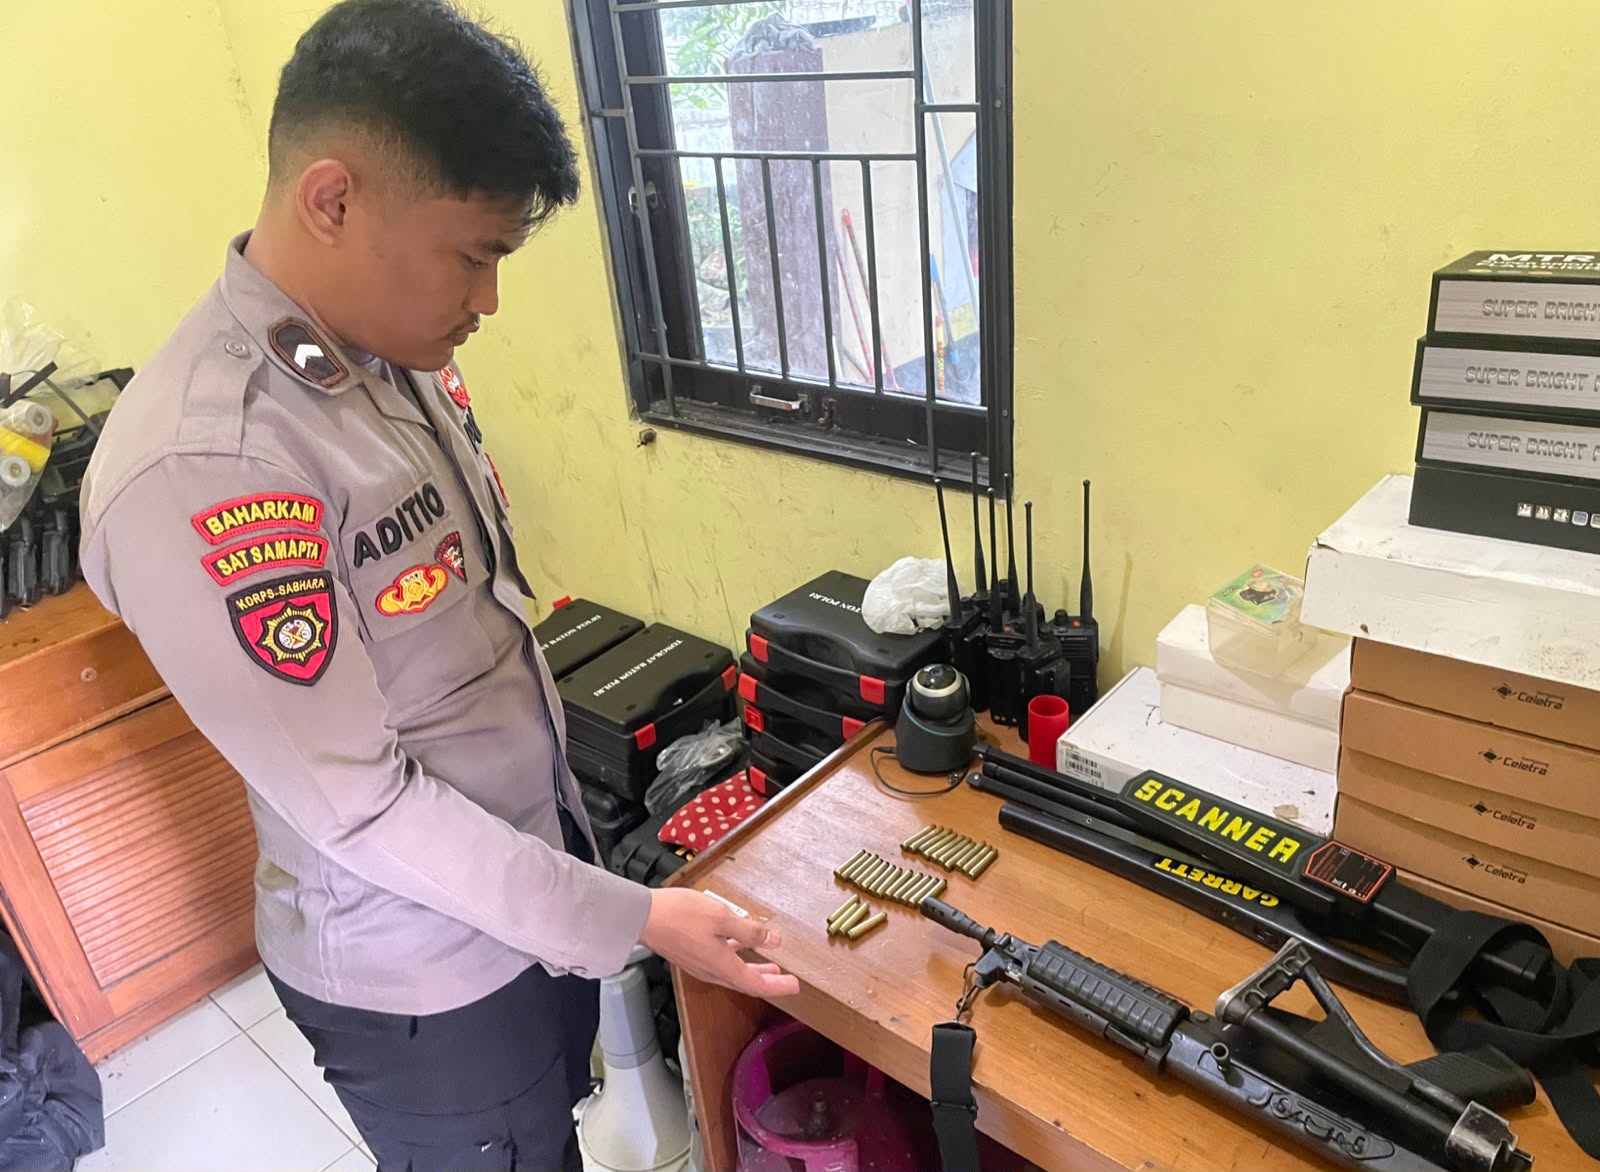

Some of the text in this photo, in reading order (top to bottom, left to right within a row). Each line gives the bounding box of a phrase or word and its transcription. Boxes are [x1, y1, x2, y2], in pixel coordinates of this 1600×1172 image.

[1482, 299, 1600, 322] SUPER BRIGH
[1465, 366, 1520, 386] SUPER
[1525, 370, 1589, 391] BRIGHT
[1467, 432, 1521, 453] SUPER
[1526, 438, 1588, 460] BRIGHT
[205, 500, 315, 535] BAHARKAM
[353, 482, 445, 568] ADITIO
[217, 539, 320, 576] SAT SAMAPTA
[235, 577, 325, 611] KORPS-SABHARA
[809, 592, 861, 613] TON POLRI
[619, 661, 648, 681] BATON
[593, 678, 622, 697] POLRI
[1517, 691, 1563, 710] Celetra
[1503, 757, 1548, 776] Celetra
[1134, 779, 1300, 863] SCANNER
[1492, 810, 1536, 830] Celetra
[1154, 857, 1280, 907] GARRETT
[1484, 864, 1527, 884] Celetra
